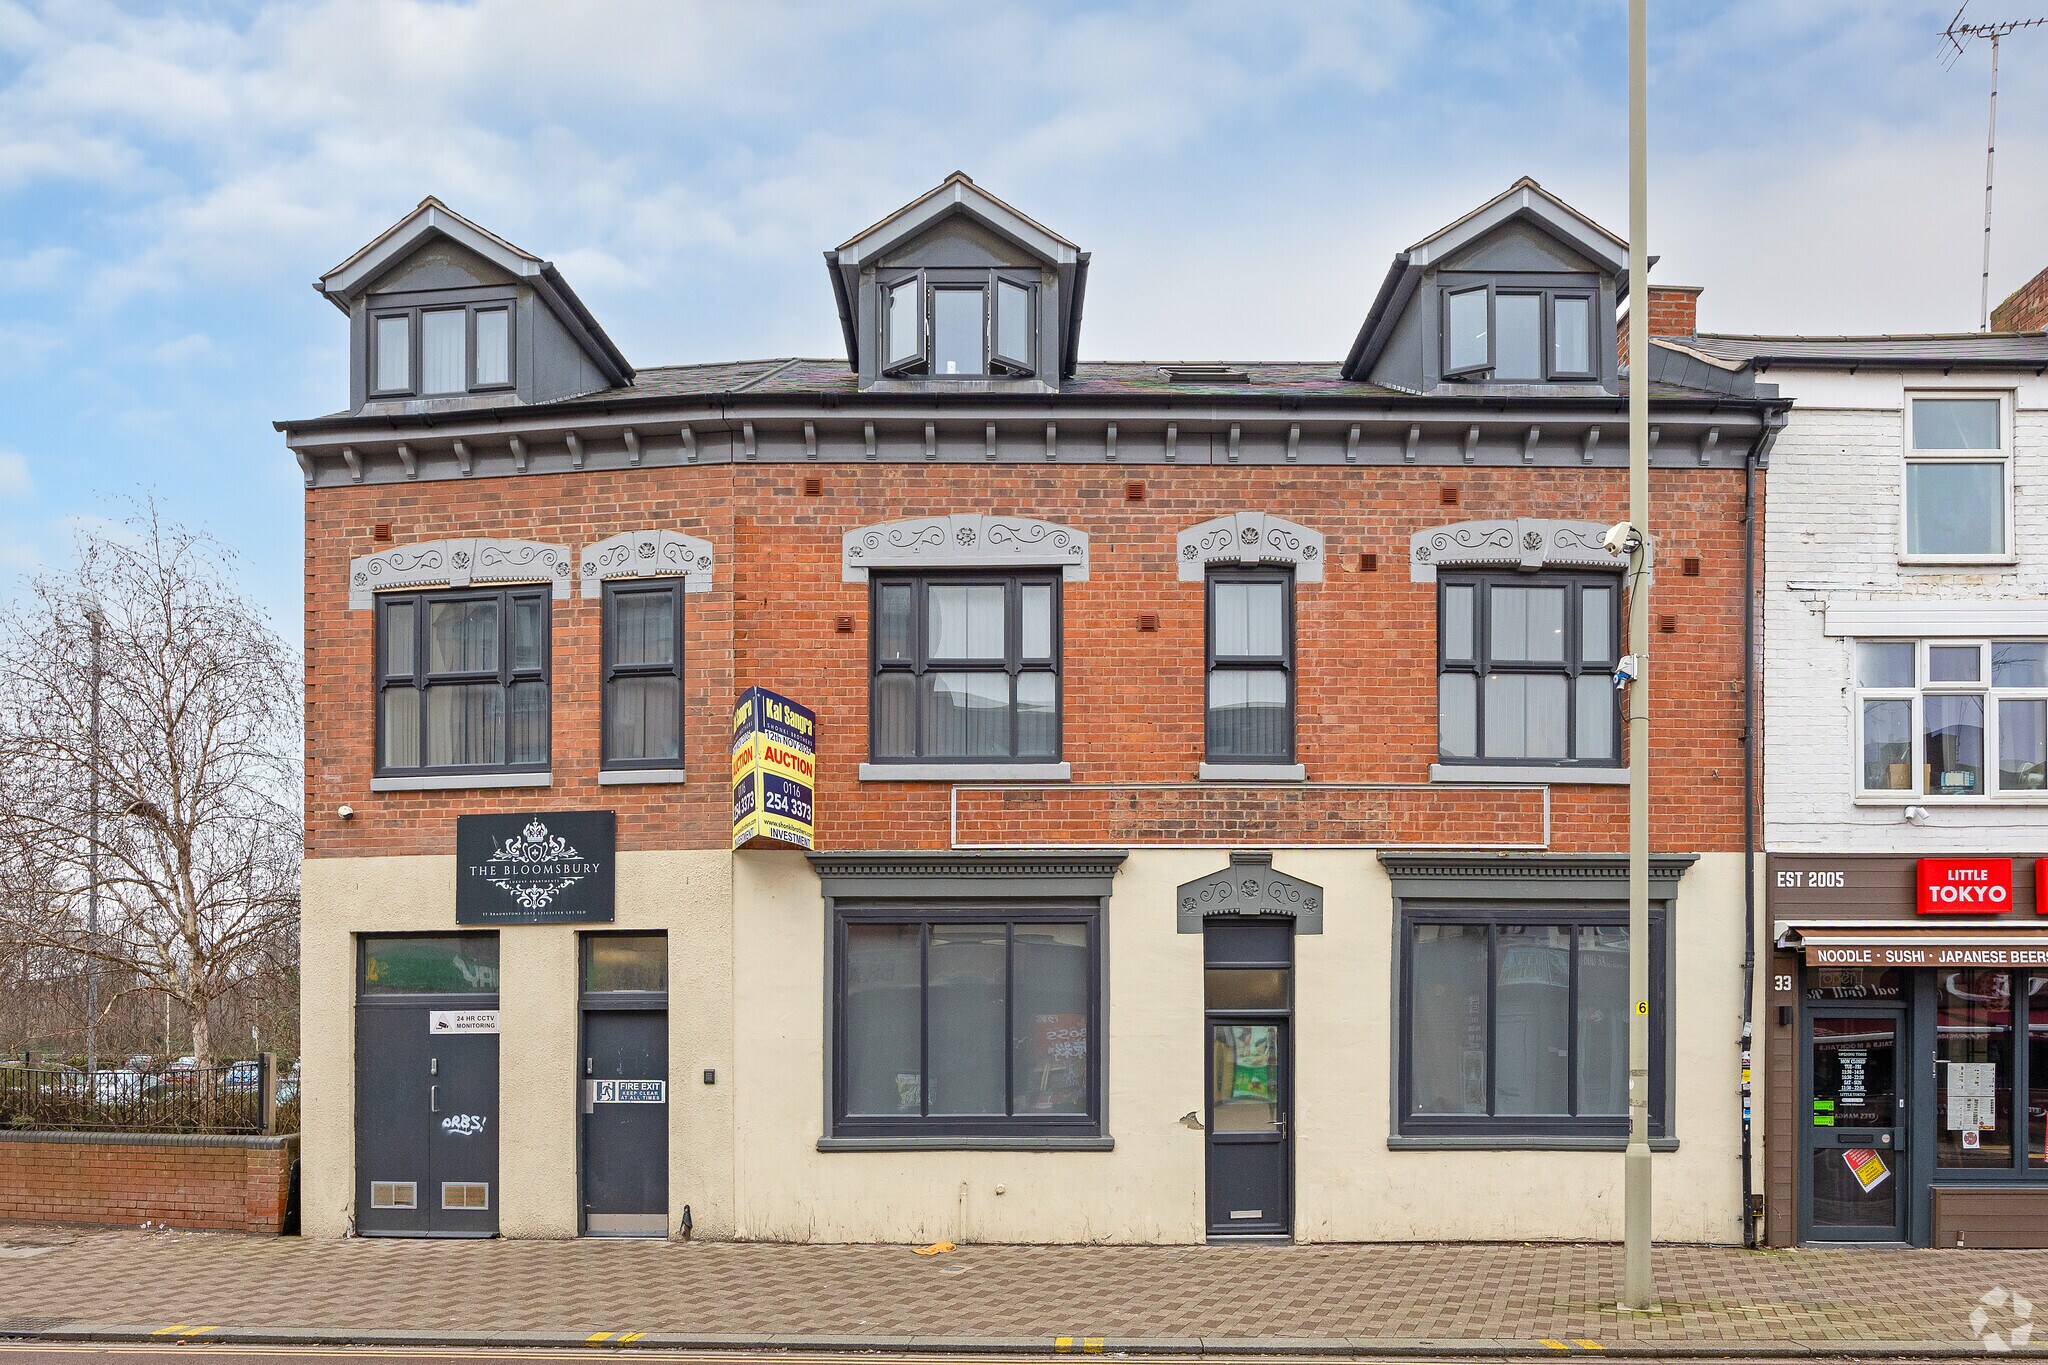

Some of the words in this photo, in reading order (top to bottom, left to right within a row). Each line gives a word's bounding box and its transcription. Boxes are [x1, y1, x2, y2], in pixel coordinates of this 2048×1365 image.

[766, 698, 782, 722] Kal
[784, 705, 812, 736] Sangra
[766, 731, 781, 743] 12th
[783, 737, 797, 749] NOV
[764, 746, 812, 777] AUCTION
[783, 782, 800, 797] 0116
[741, 791, 754, 814] 3373
[767, 792, 788, 812] 254
[791, 799, 811, 820] 3373
[770, 828, 810, 847] INVESTMENT
[470, 866, 496, 876] THE
[504, 863, 600, 875] BLOOMSBURY
[1948, 870, 1987, 881] LITTLE
[1777, 872, 1803, 887] EST
[1809, 872, 1844, 887] 2005
[1929, 886, 2006, 902] TOKYO
[1818, 950, 1872, 962] NOODLE
[1886, 950, 1924, 962] SUSHI
[1939, 950, 2007, 963] JAPANESE
[1775, 976, 1791, 991] 33
[1639, 1002, 1646, 1013] 6
